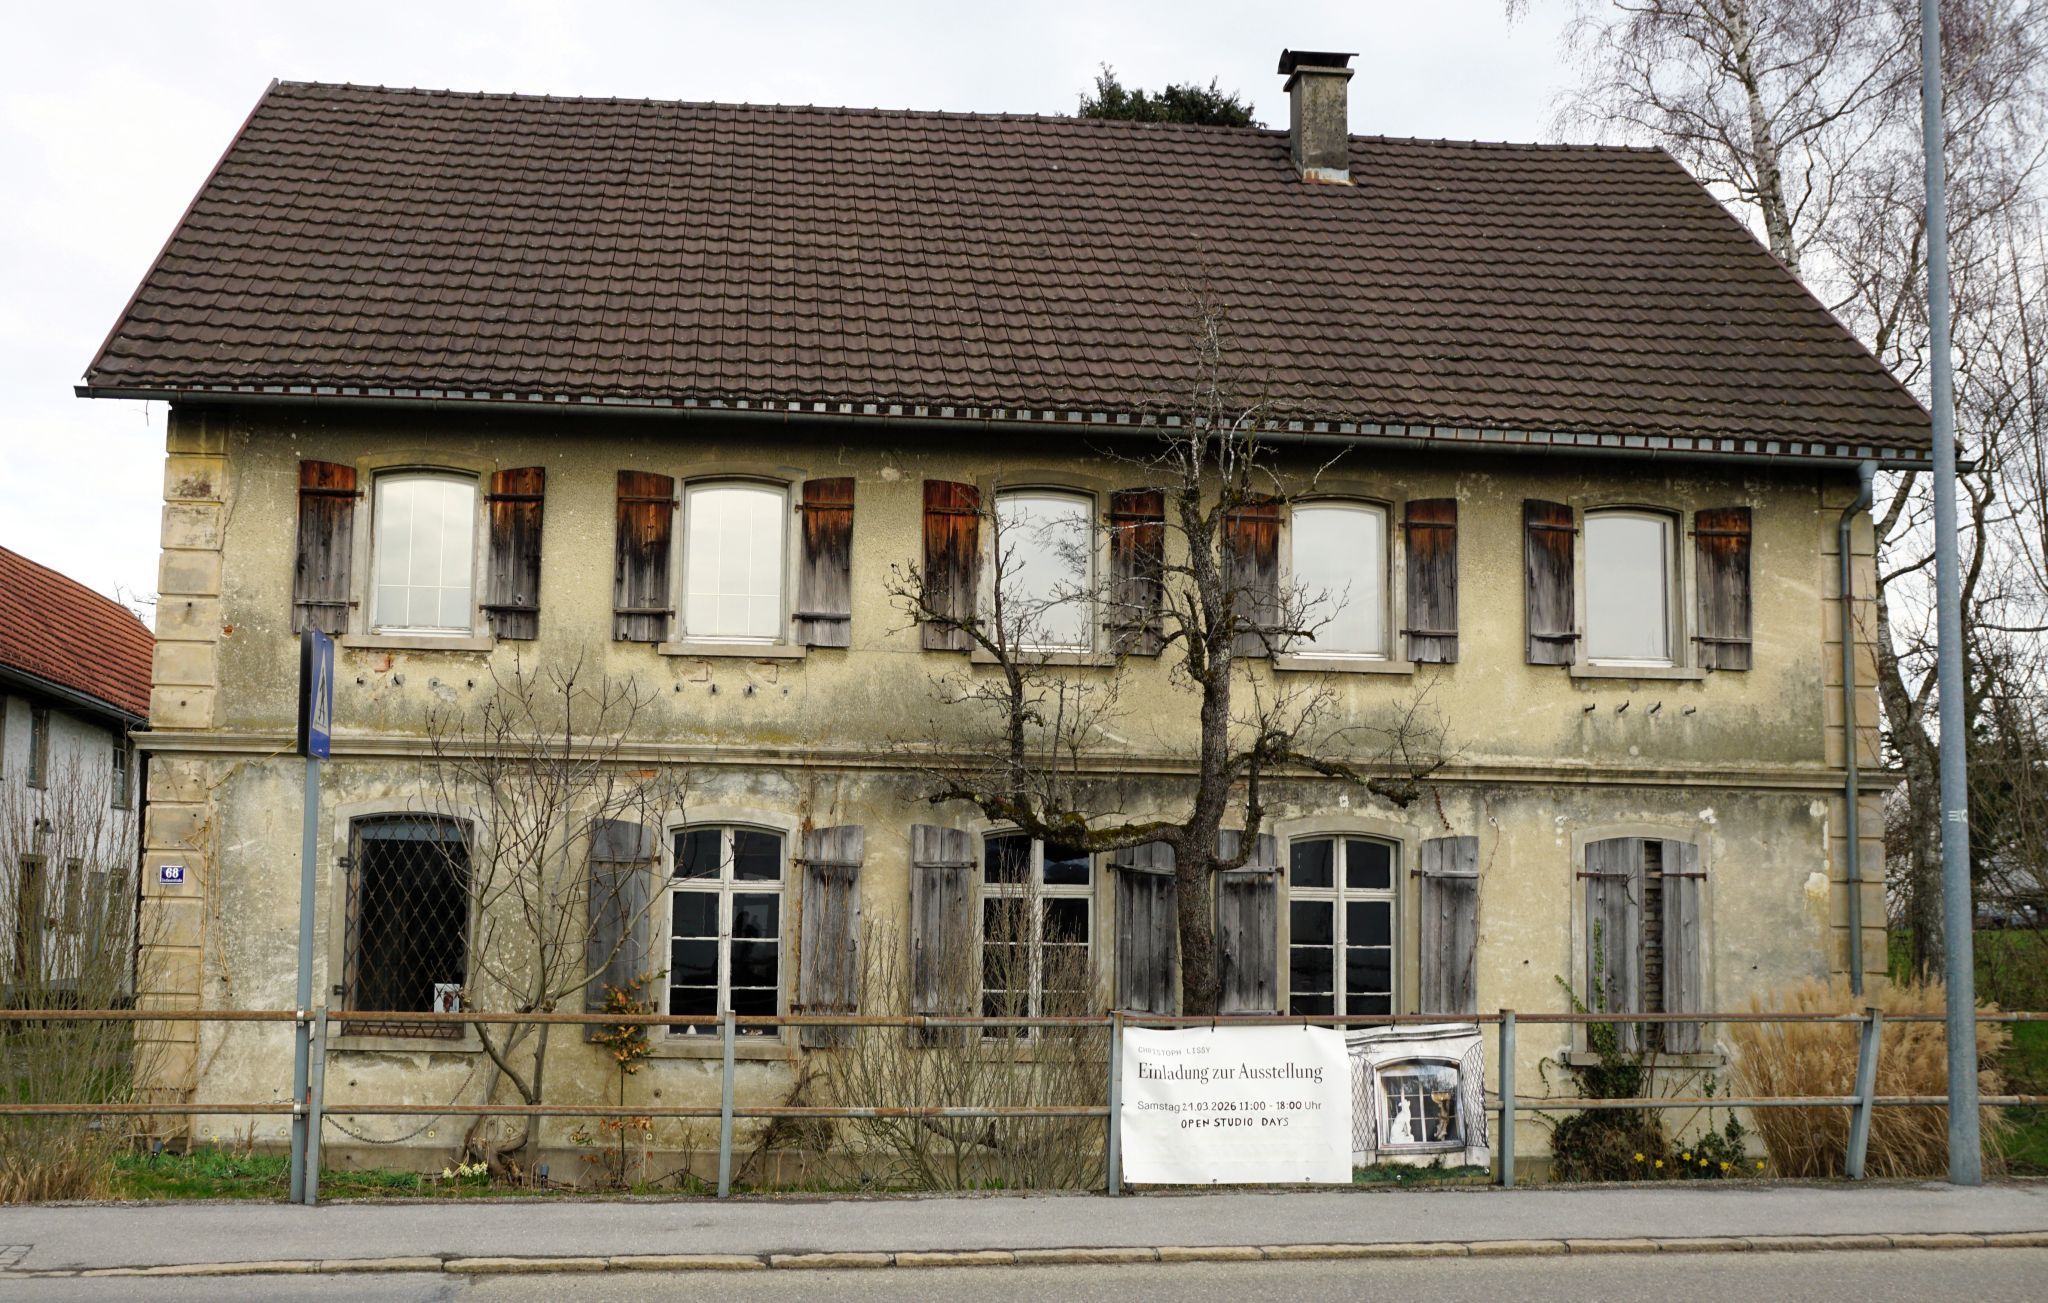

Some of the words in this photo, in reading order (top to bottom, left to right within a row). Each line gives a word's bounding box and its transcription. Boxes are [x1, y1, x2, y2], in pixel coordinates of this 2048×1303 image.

[165, 867, 179, 879] 68
[1186, 1046, 1211, 1055] LISSY
[1138, 1062, 1209, 1085] Einladung
[1212, 1068, 1236, 1080] zur
[1239, 1062, 1323, 1084] Ausstellung
[1137, 1101, 1181, 1114] Samstag
[1182, 1101, 1237, 1112] 21.03.2026
[1239, 1101, 1266, 1111] 11:00
[1276, 1101, 1302, 1110] 18:00
[1304, 1101, 1322, 1110] Uhr
[1180, 1118, 1210, 1129] OPEN
[1213, 1117, 1253, 1128] STUDIO
[1261, 1117, 1289, 1127] DAYS
